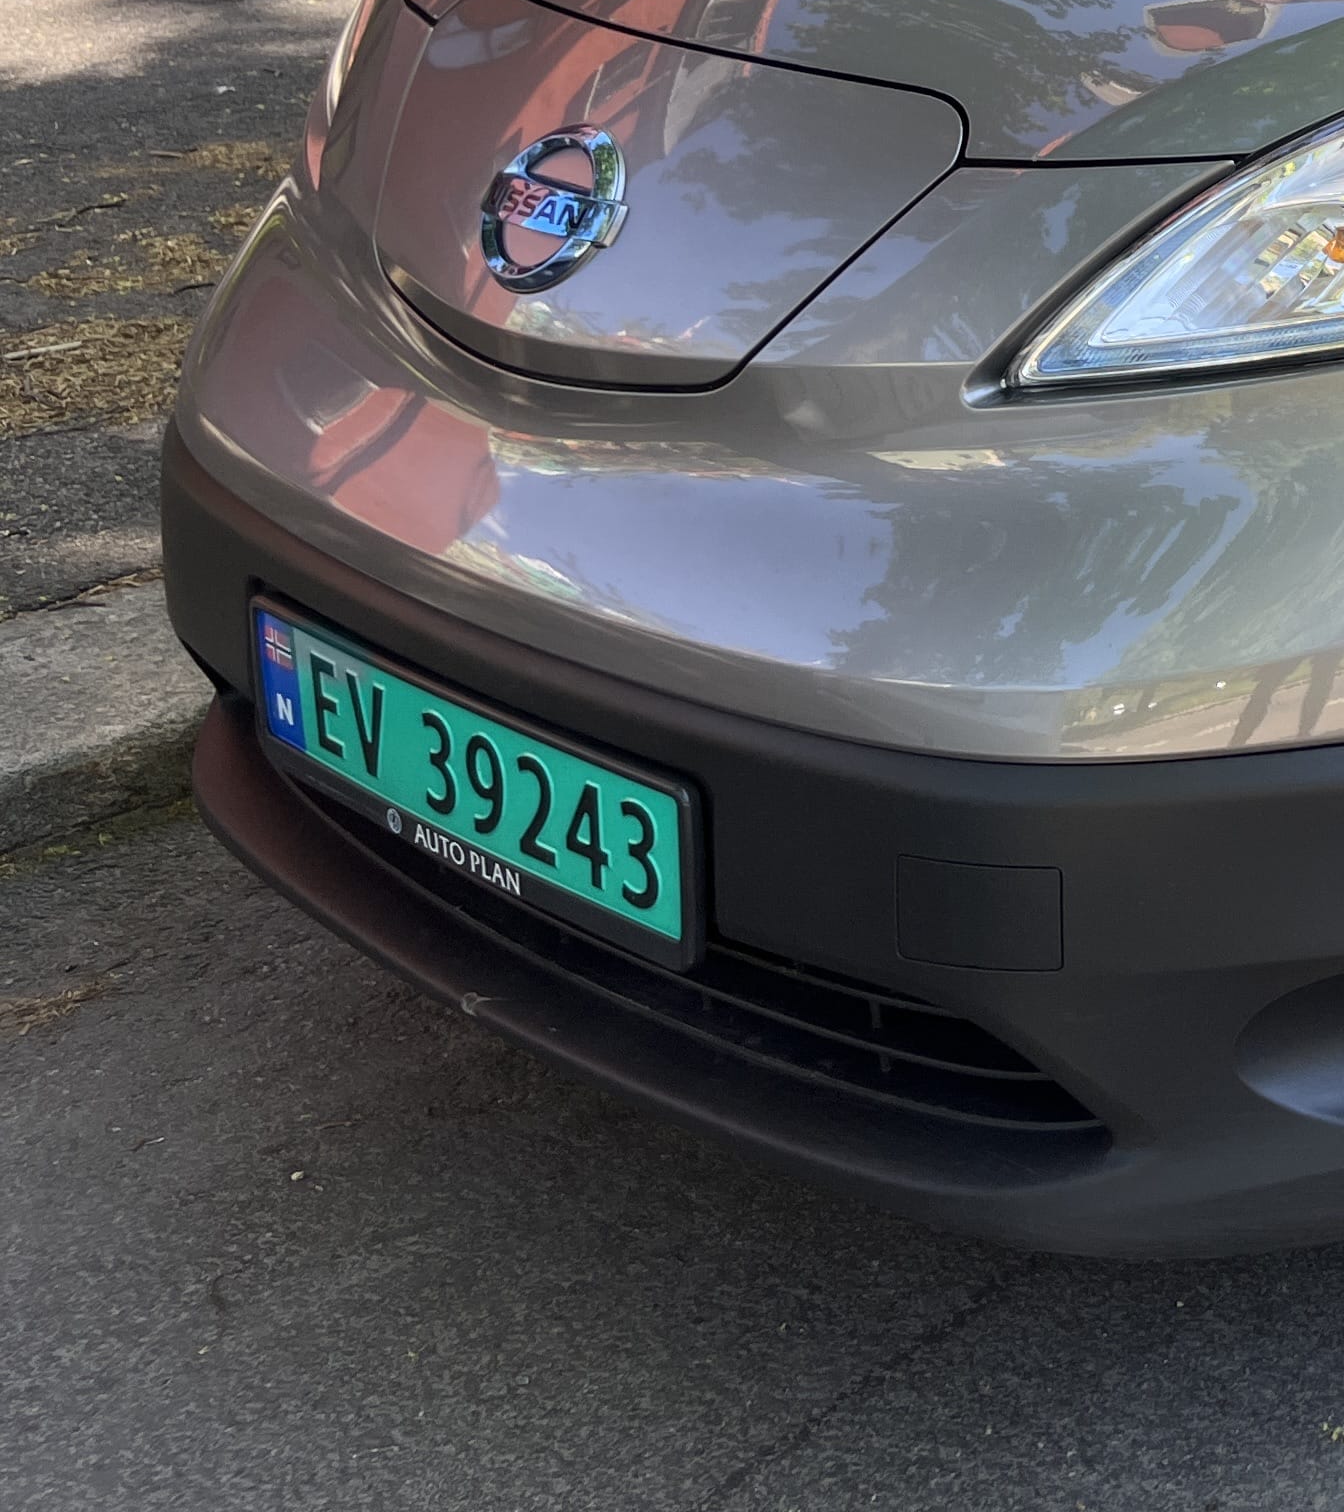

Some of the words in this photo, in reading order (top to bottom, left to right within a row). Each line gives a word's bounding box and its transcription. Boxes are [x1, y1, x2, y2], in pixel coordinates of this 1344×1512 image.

[490, 176, 588, 229] SSAN
[275, 692, 295, 727] N
[309, 651, 385, 779] EV
[421, 708, 661, 910] 39243
[414, 823, 465, 866] AUTO
[469, 849, 520, 896] PLAN
